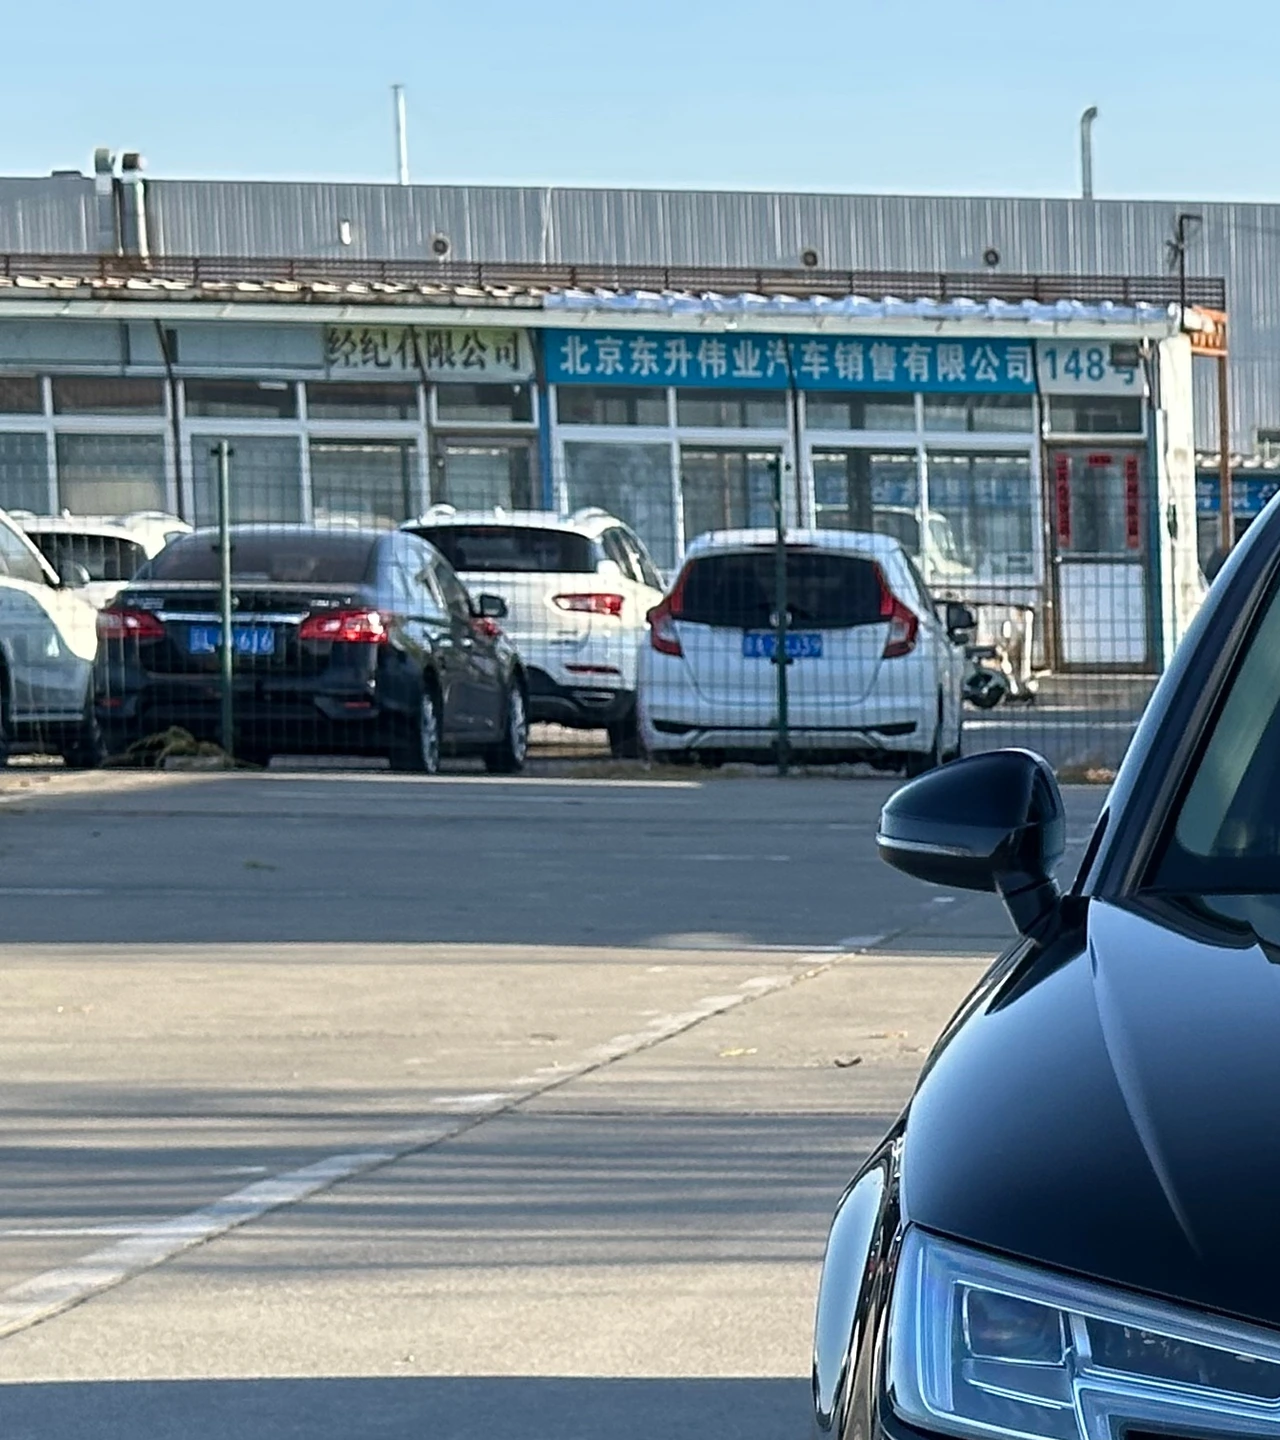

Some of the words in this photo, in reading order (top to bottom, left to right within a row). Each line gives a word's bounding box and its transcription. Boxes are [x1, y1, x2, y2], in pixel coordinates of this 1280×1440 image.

[559, 335, 1034, 384] 北京东升伟业汽车销售有限公司
